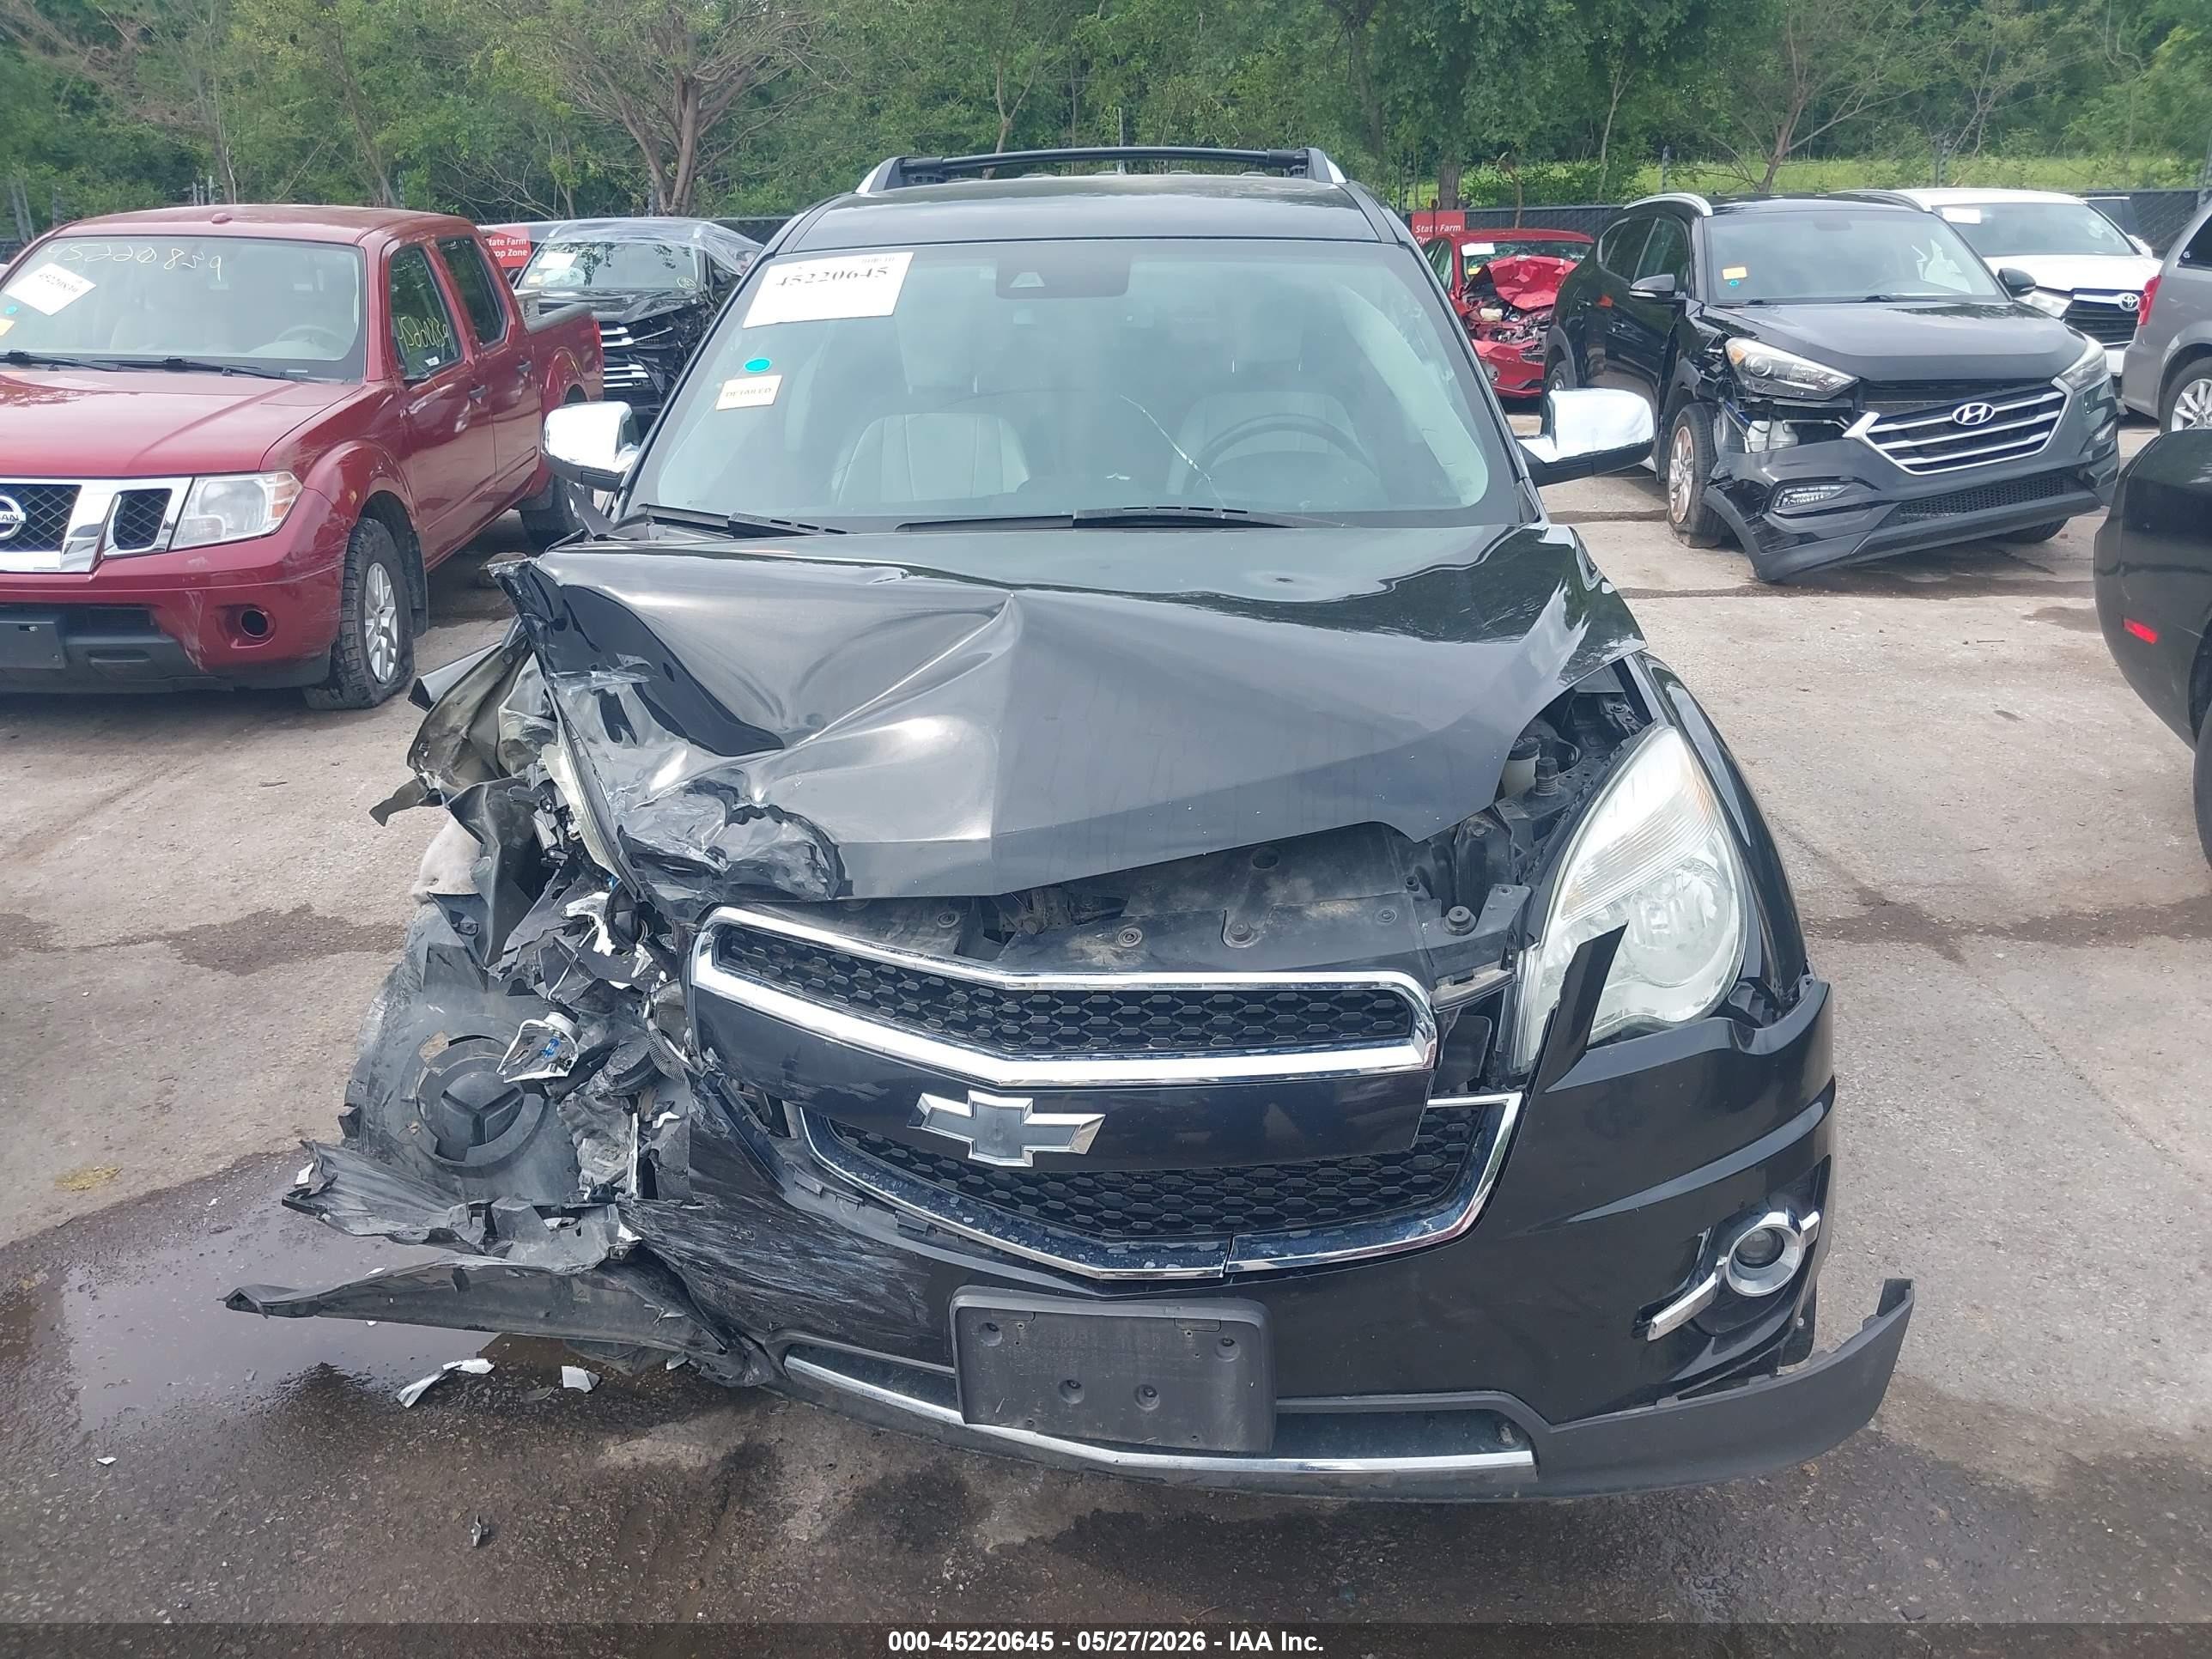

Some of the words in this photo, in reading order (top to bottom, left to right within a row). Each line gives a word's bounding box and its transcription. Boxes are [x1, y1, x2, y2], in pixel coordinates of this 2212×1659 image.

[1439, 223, 1462, 233] Farm
[485, 237, 506, 246] tate
[507, 237, 526, 246] Farm
[507, 248, 528, 257] Zone
[775, 266, 890, 288] 45220645
